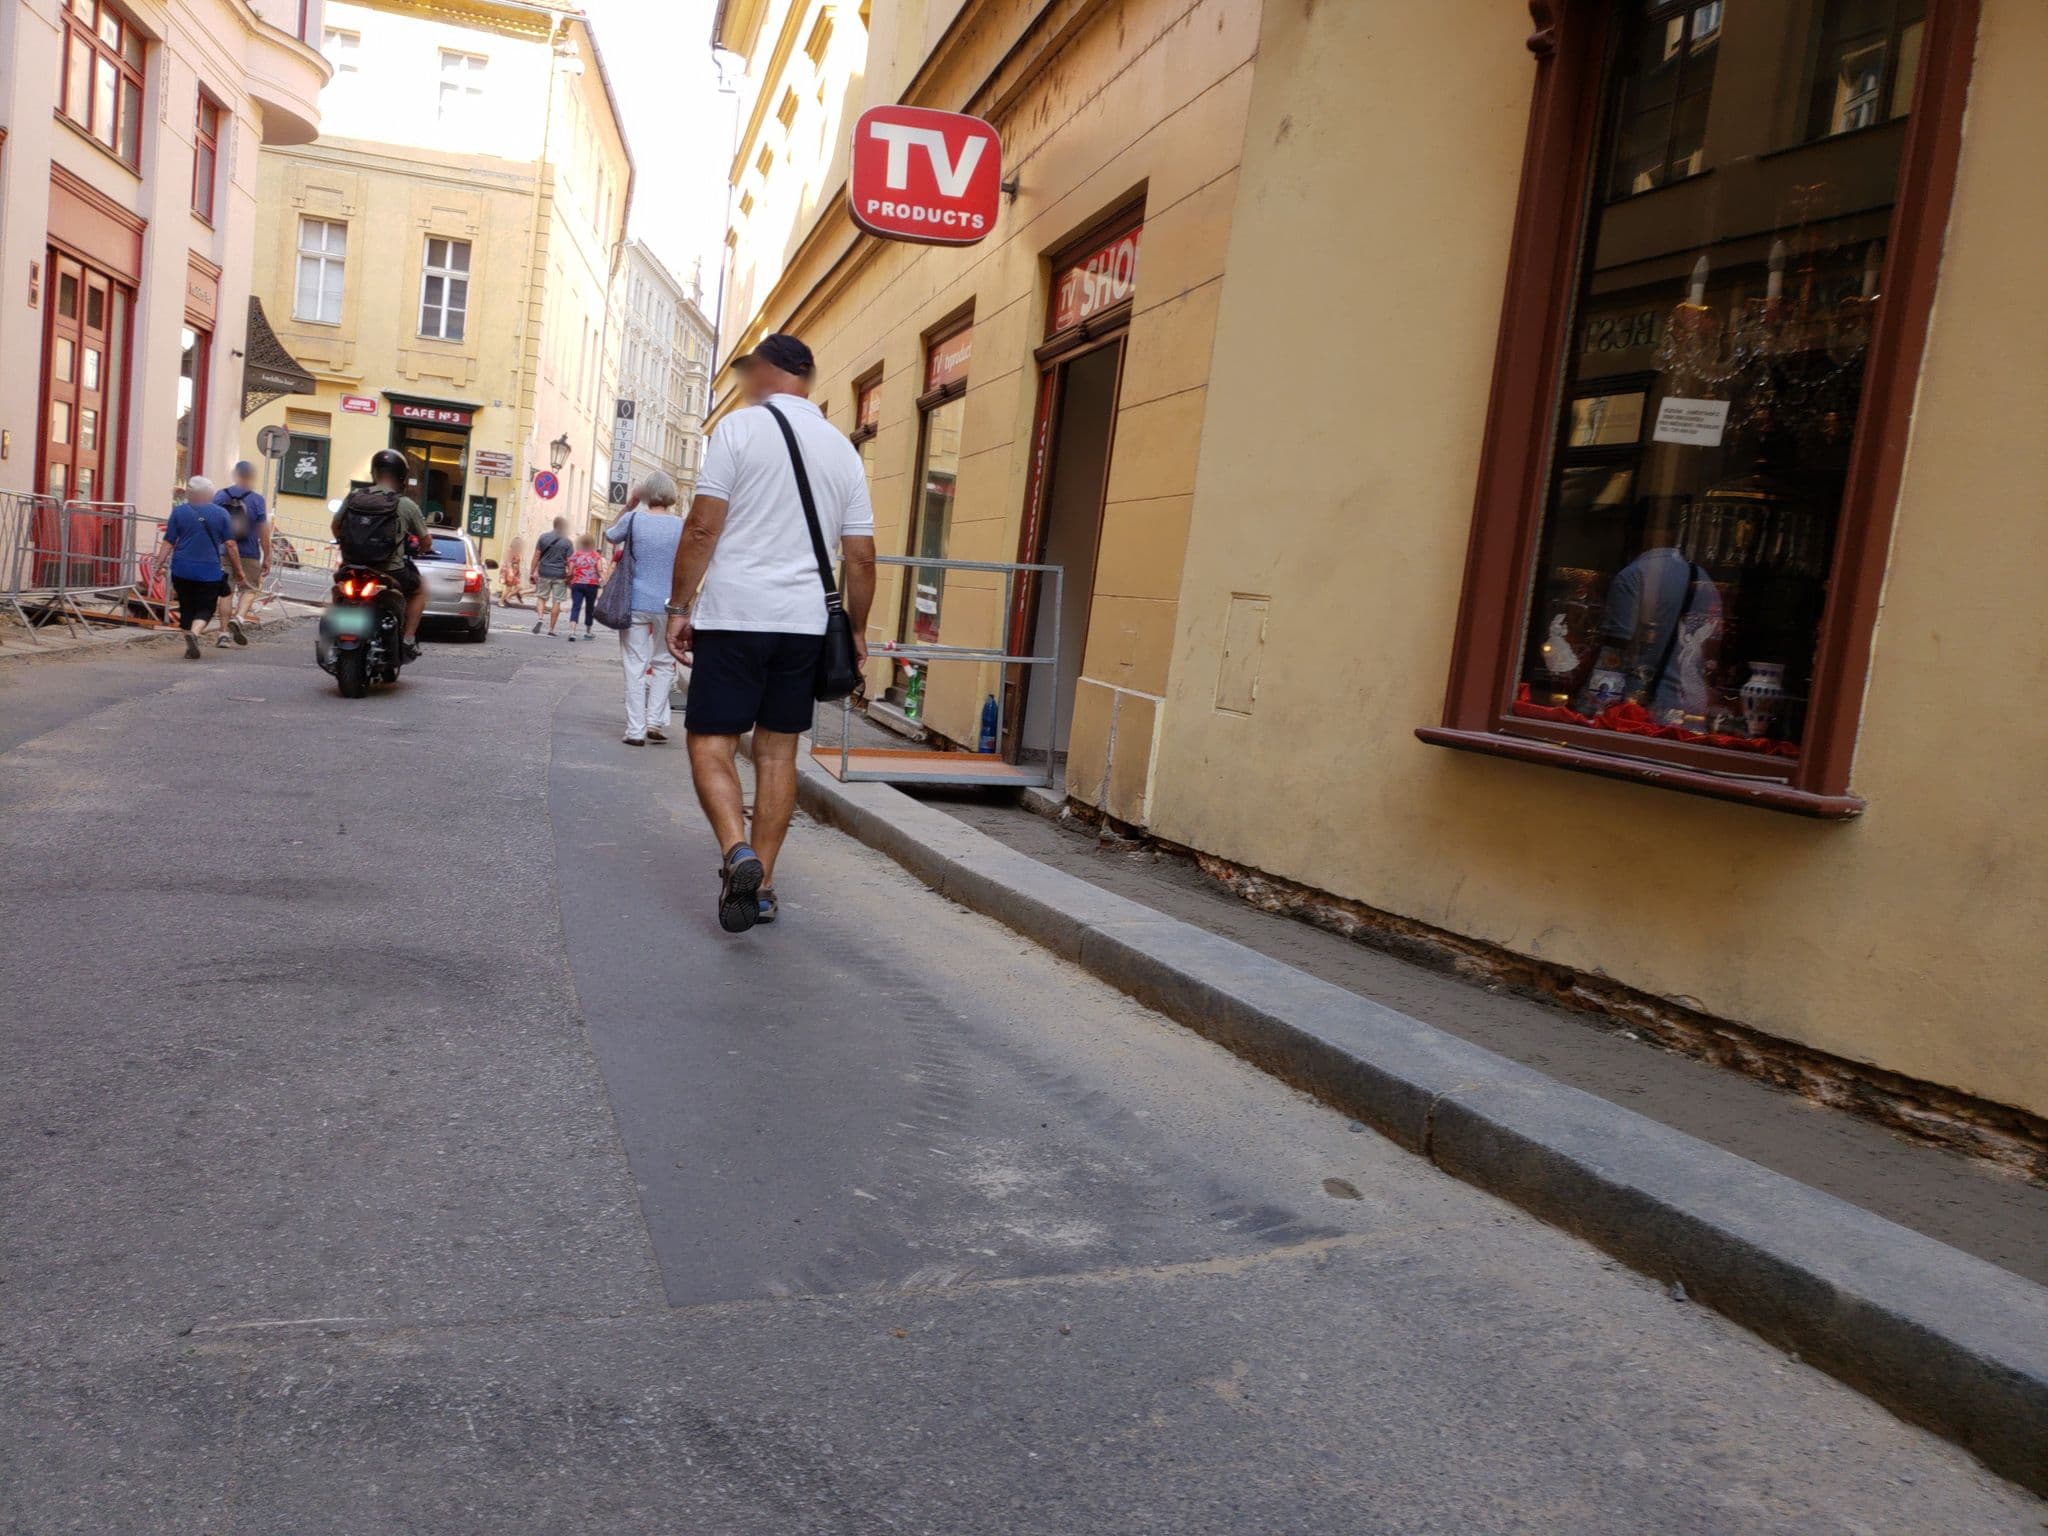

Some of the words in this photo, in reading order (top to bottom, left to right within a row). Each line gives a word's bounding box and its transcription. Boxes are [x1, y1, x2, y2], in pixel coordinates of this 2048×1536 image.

[870, 121, 988, 198] TV
[867, 200, 984, 229] PRODUCTS
[1061, 275, 1078, 313] TV
[403, 406, 435, 419] CAFE
